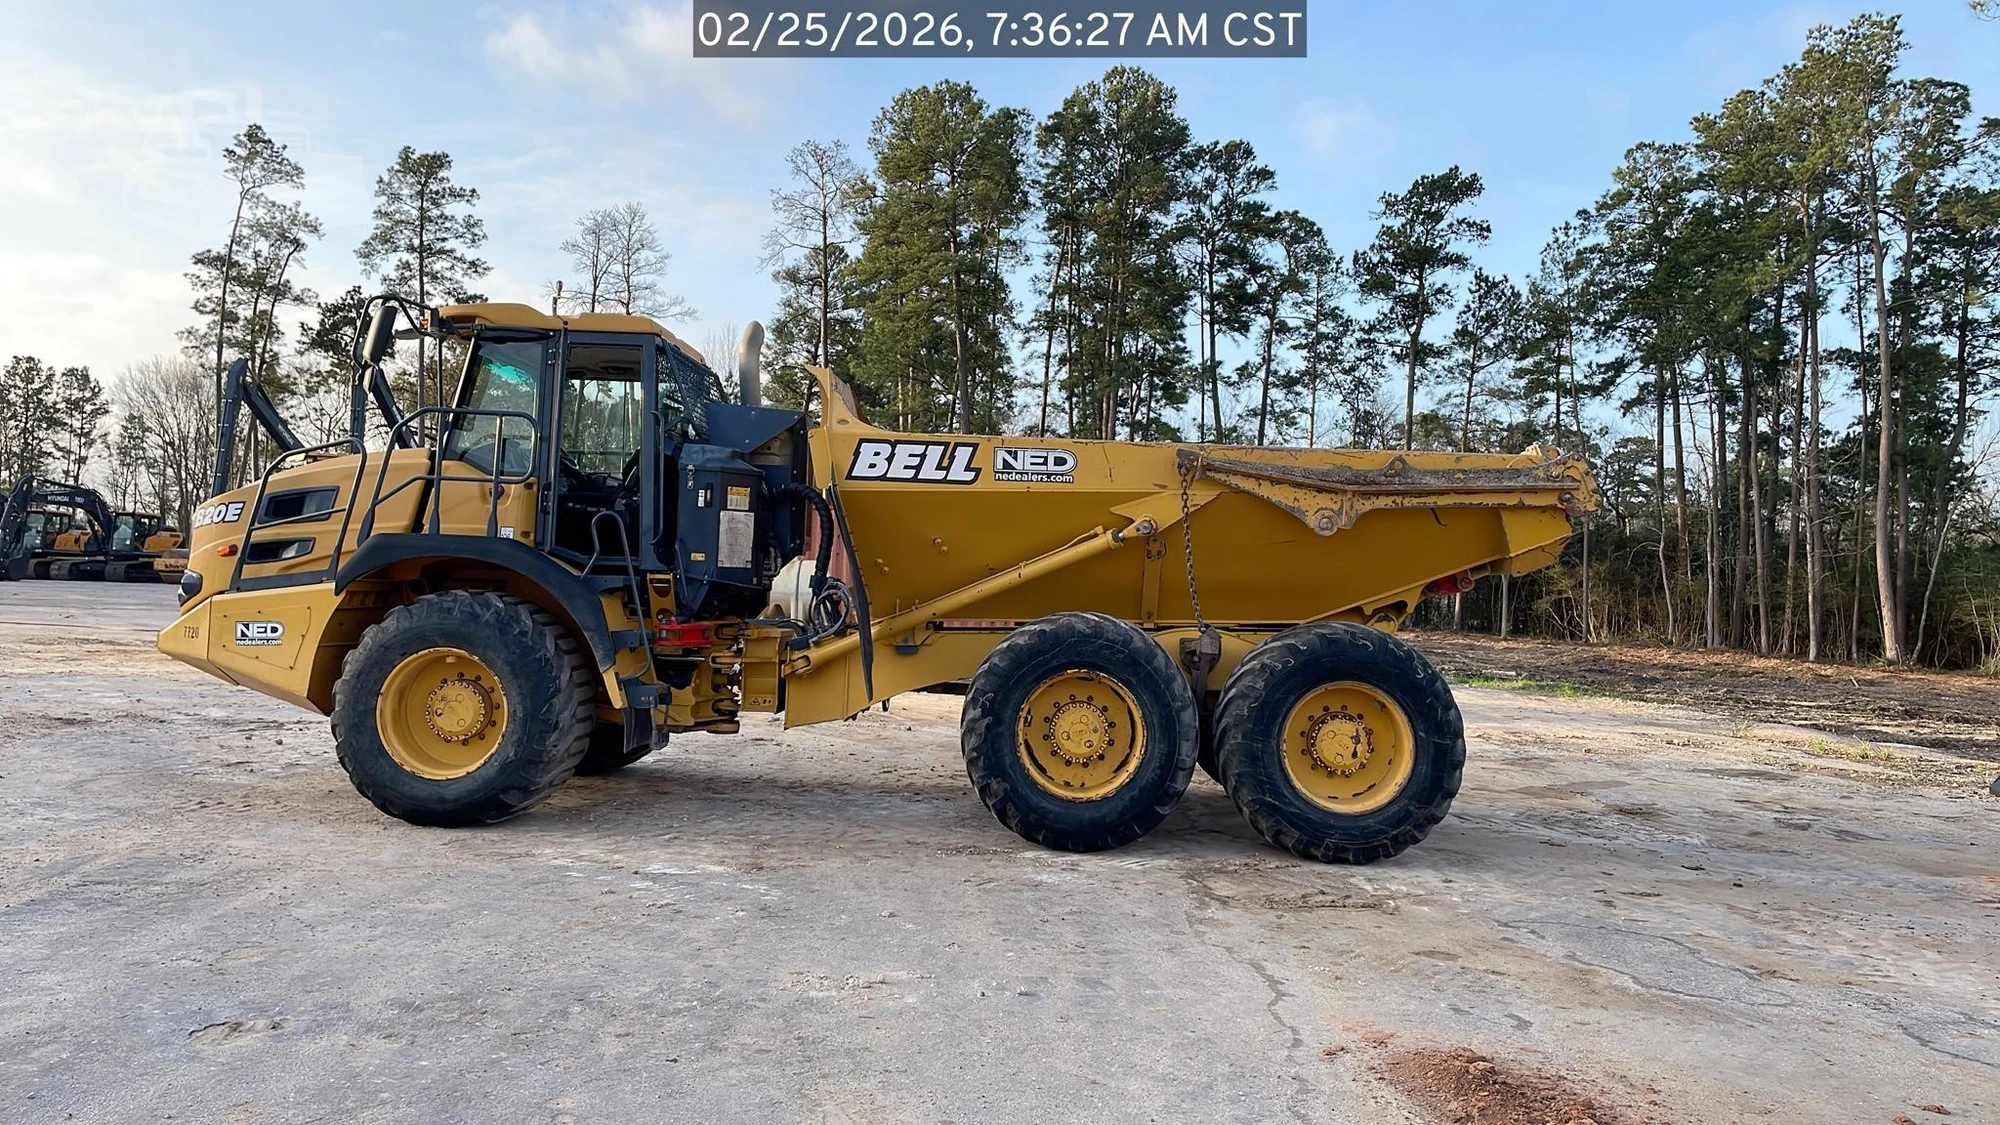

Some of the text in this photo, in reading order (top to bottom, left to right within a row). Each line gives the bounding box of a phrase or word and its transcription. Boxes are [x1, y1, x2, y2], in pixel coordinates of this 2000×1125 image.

[848, 440, 981, 483] BELL
[996, 448, 1076, 472] NED
[995, 472, 1074, 483] nedealers.com
[236, 622, 284, 639] NED
